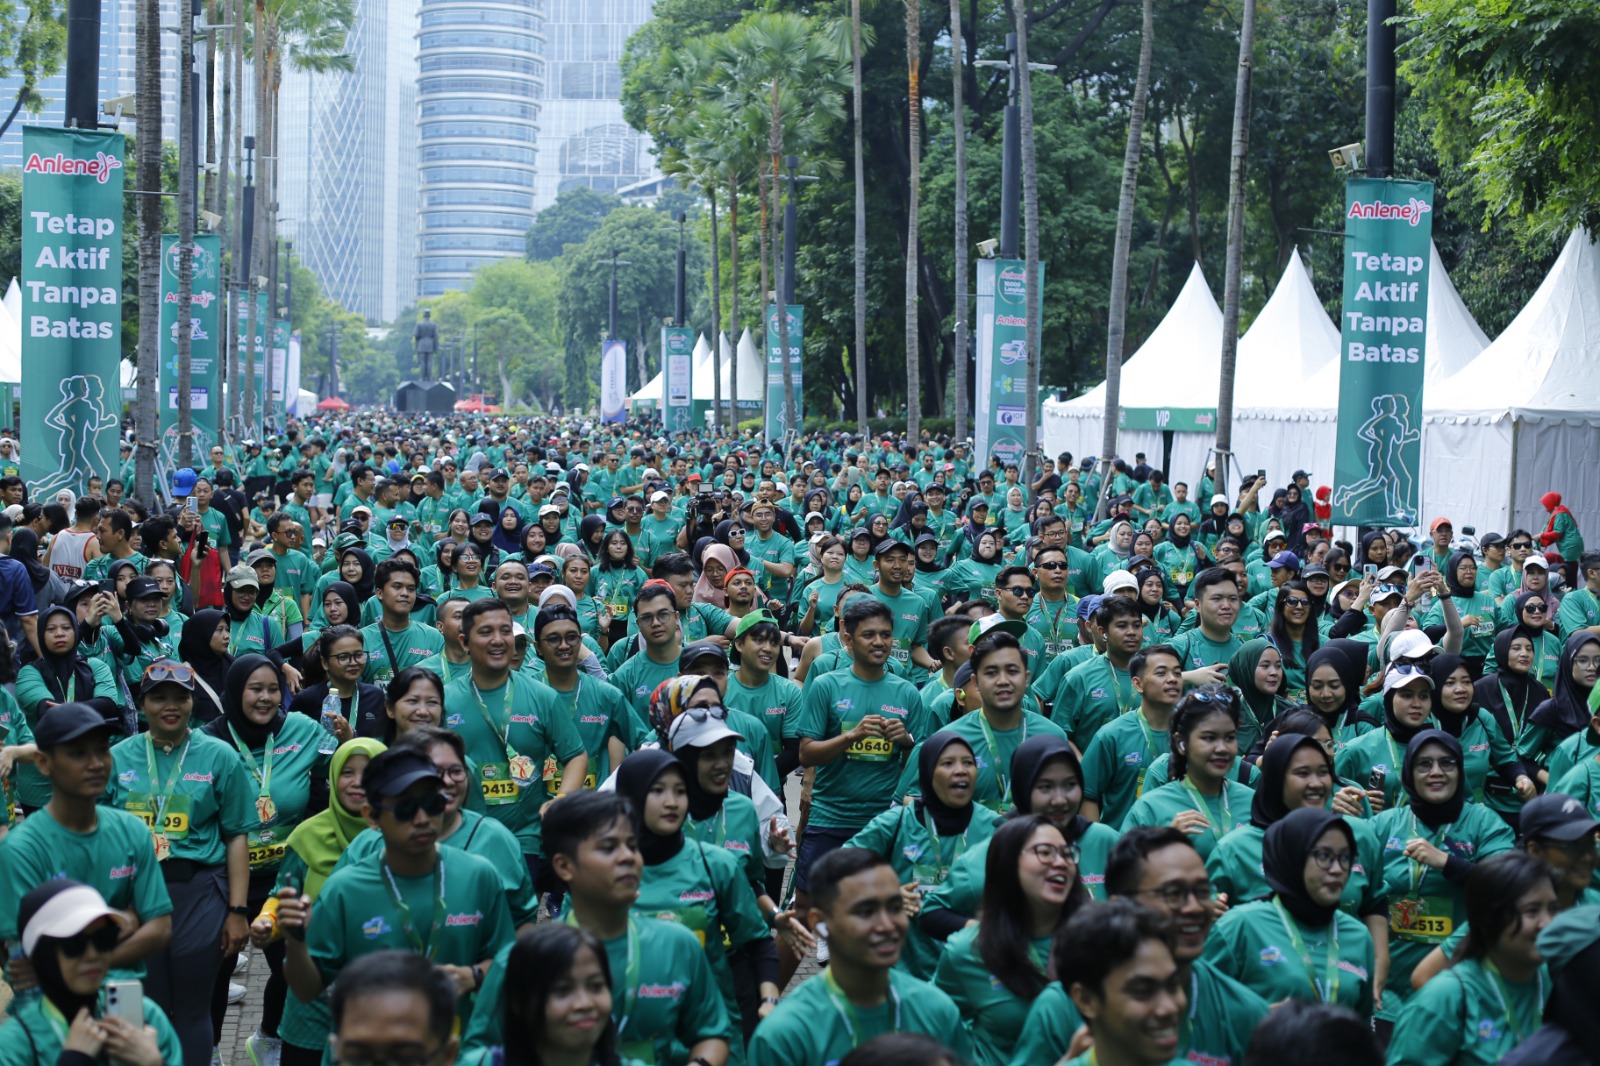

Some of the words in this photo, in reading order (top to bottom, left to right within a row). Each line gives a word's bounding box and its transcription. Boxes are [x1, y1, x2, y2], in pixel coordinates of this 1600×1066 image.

[25, 154, 100, 175] Anlene
[1349, 200, 1412, 219] Anlene
[30, 212, 115, 240] Tetap
[35, 246, 111, 270] Aktif
[1351, 252, 1424, 276] Tetap
[26, 281, 117, 308] Tanpa
[1354, 282, 1419, 303] Aktif
[30, 316, 113, 338] Batas
[1346, 312, 1424, 336] Tanpa
[1348, 342, 1420, 363] Batas
[1156, 410, 1170, 427] VIP
[510, 714, 533, 723] nlene
[482, 783, 514, 796] 0413
